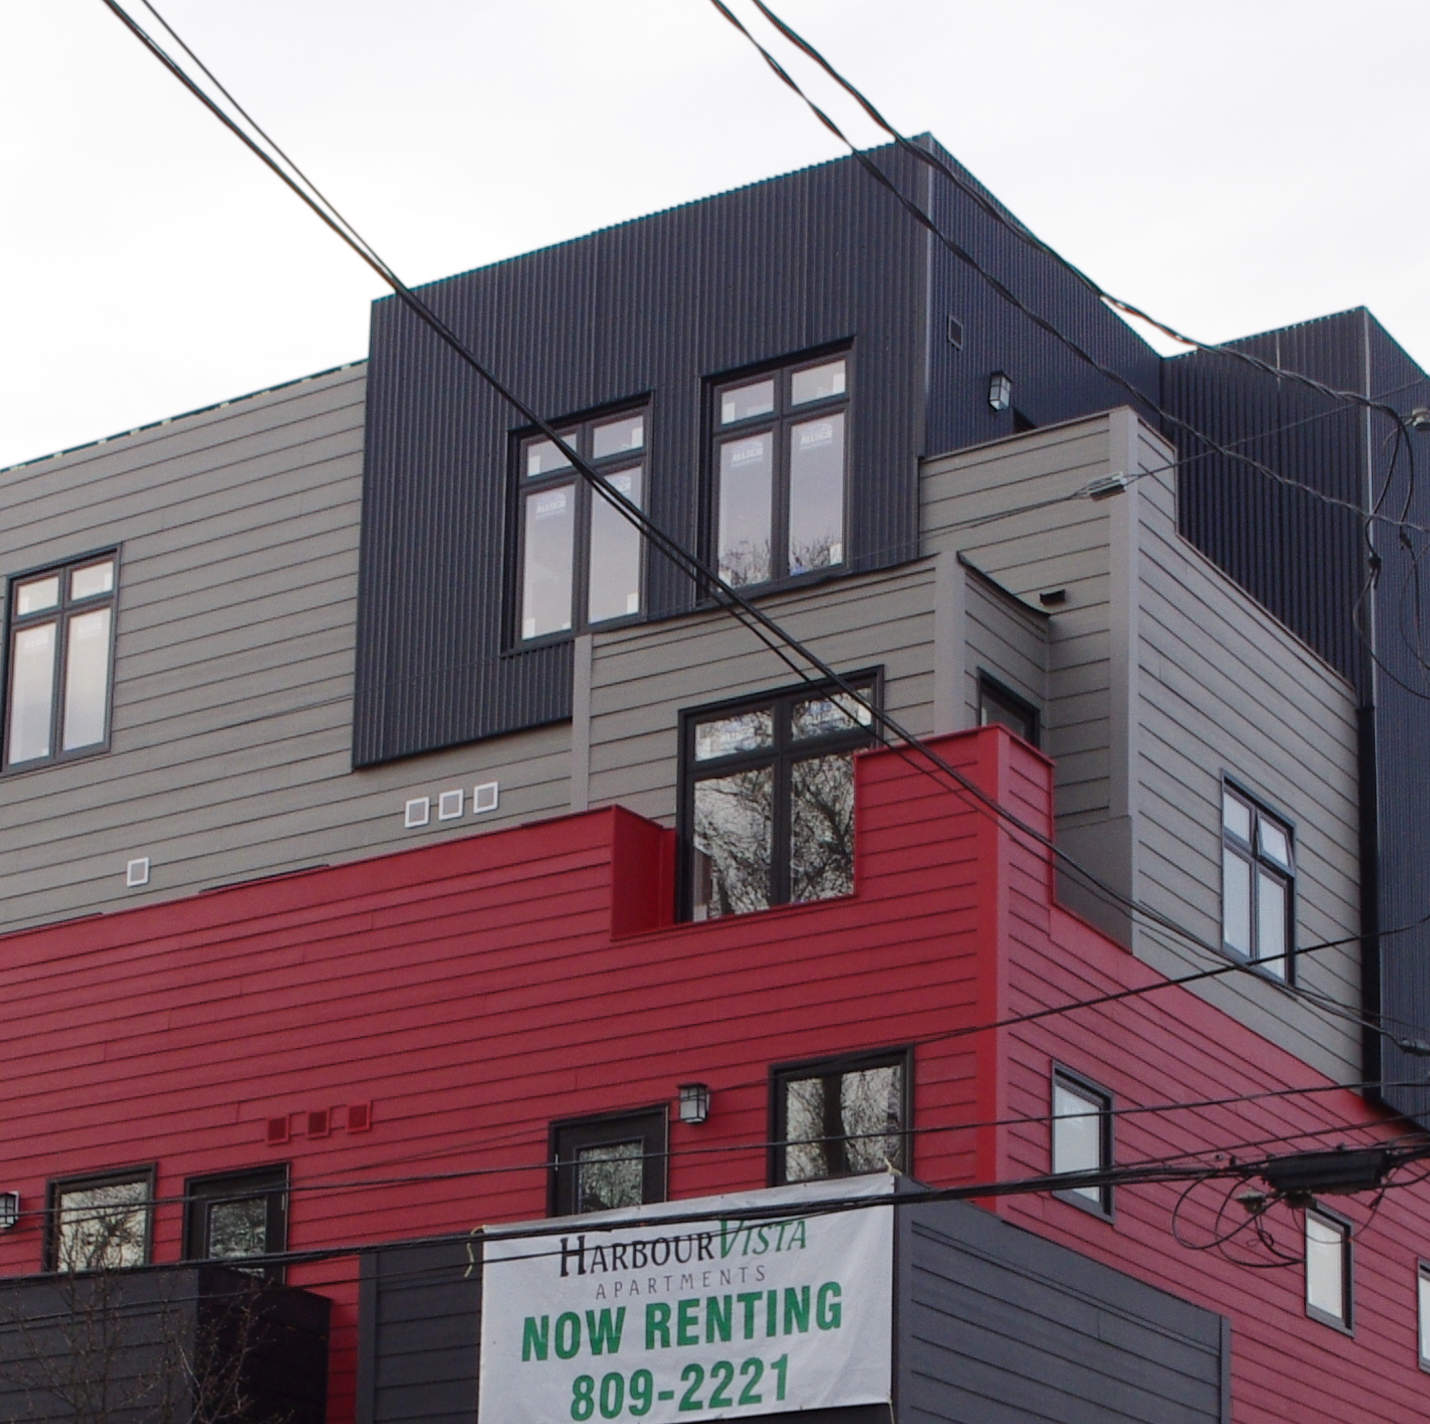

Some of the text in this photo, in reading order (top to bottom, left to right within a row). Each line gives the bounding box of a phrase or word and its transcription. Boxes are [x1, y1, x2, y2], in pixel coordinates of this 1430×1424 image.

[596, 1265, 766, 1299] APARTMENTS
[522, 1281, 842, 1362] NOW RENTING
[571, 1353, 789, 1421] 809-2221
